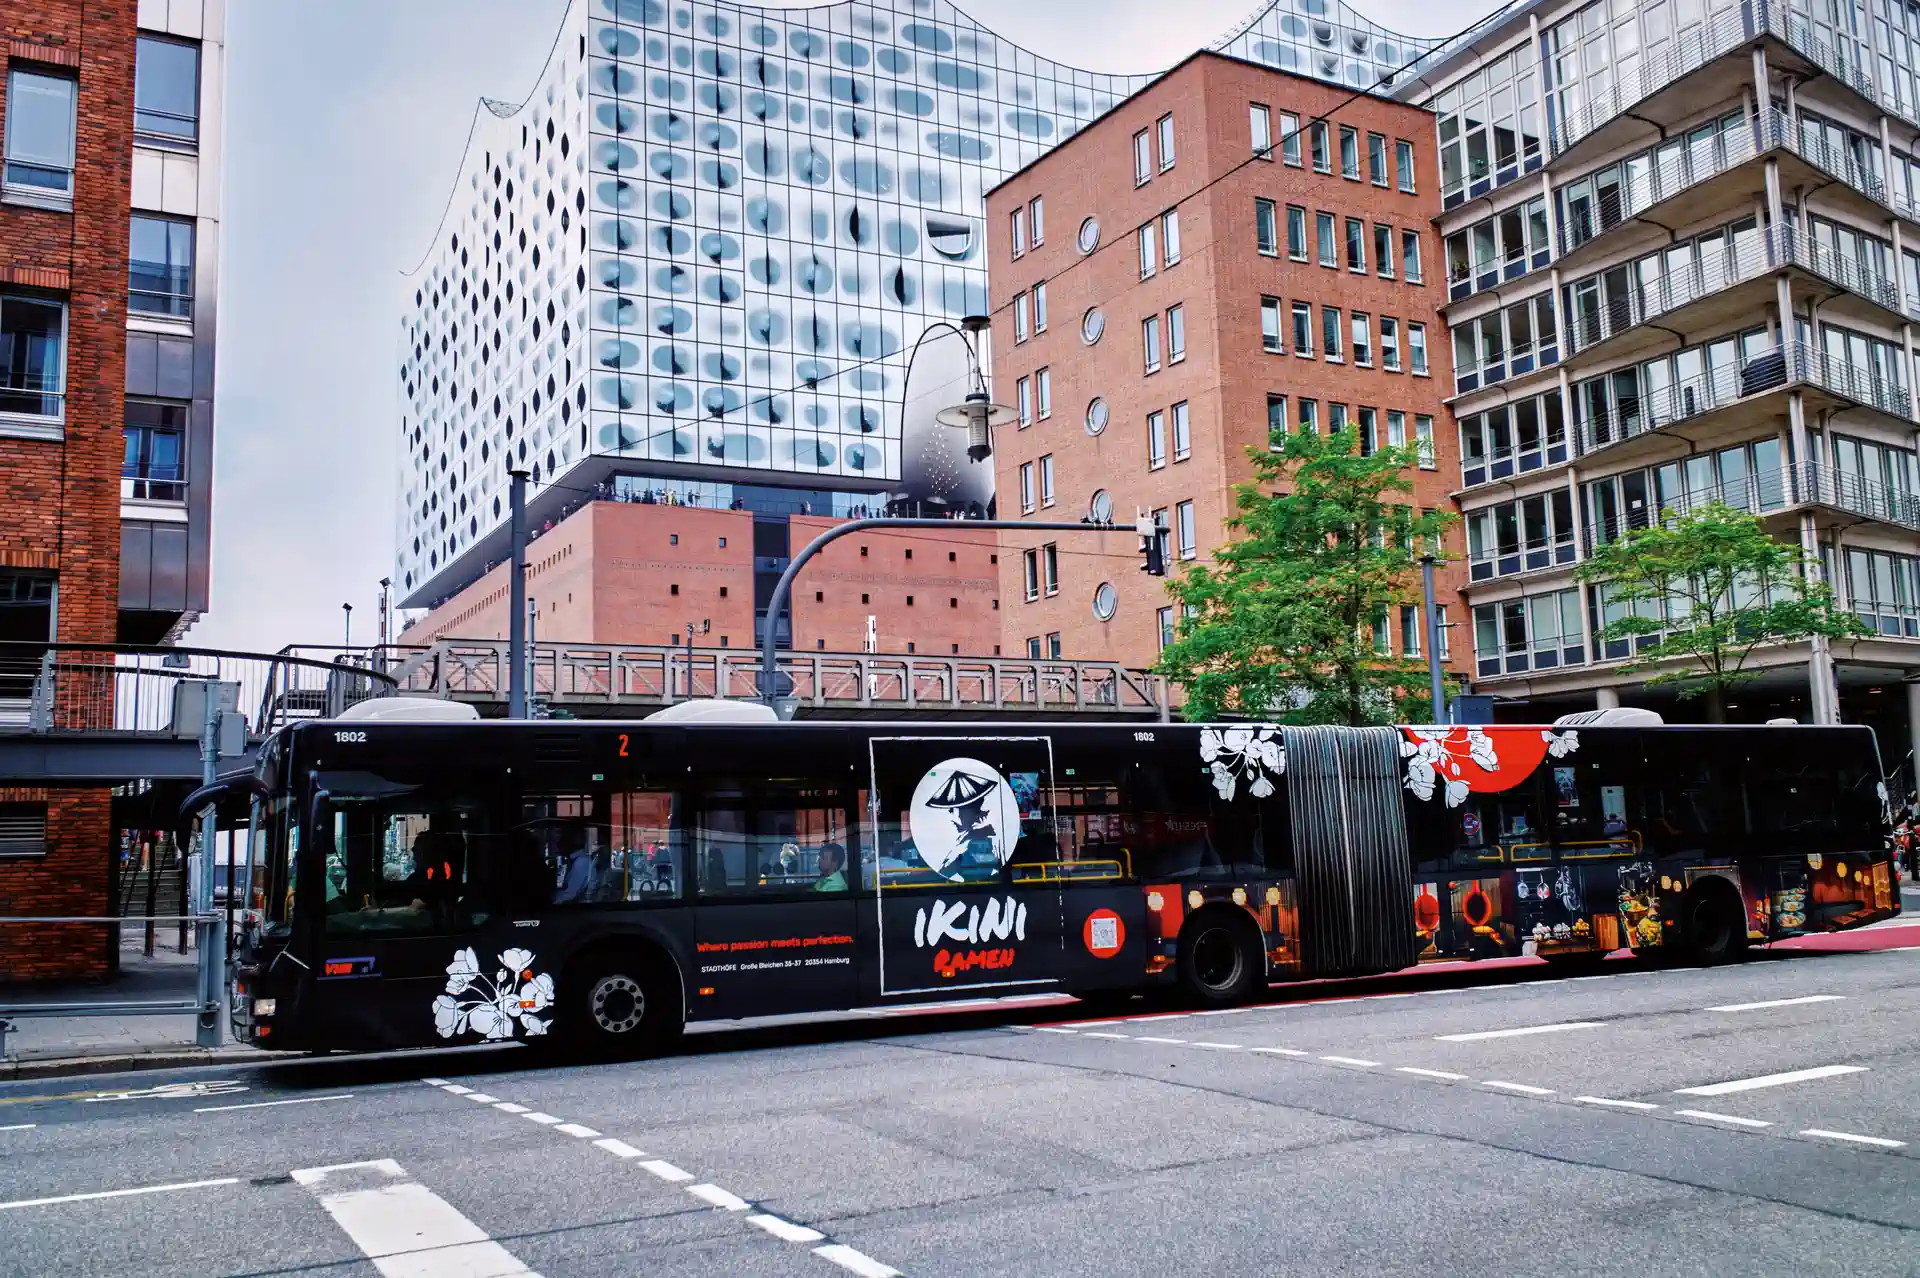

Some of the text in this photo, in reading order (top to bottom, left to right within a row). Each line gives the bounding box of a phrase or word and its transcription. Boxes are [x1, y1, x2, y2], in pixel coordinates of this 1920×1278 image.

[334, 731, 367, 742] 1802
[1133, 732, 1155, 741] 1802
[619, 734, 629, 757] 2
[914, 895, 1027, 948] IKINI
[697, 942, 728, 952] Where
[731, 940, 768, 952] passion
[771, 937, 800, 948] meets
[701, 964, 737, 973] STADTHÖFE
[740, 962, 758, 970] Große
[759, 961, 784, 969] Bleichen
[805, 958, 823, 966] 20354
[933, 949, 1015, 973] RAMEN
